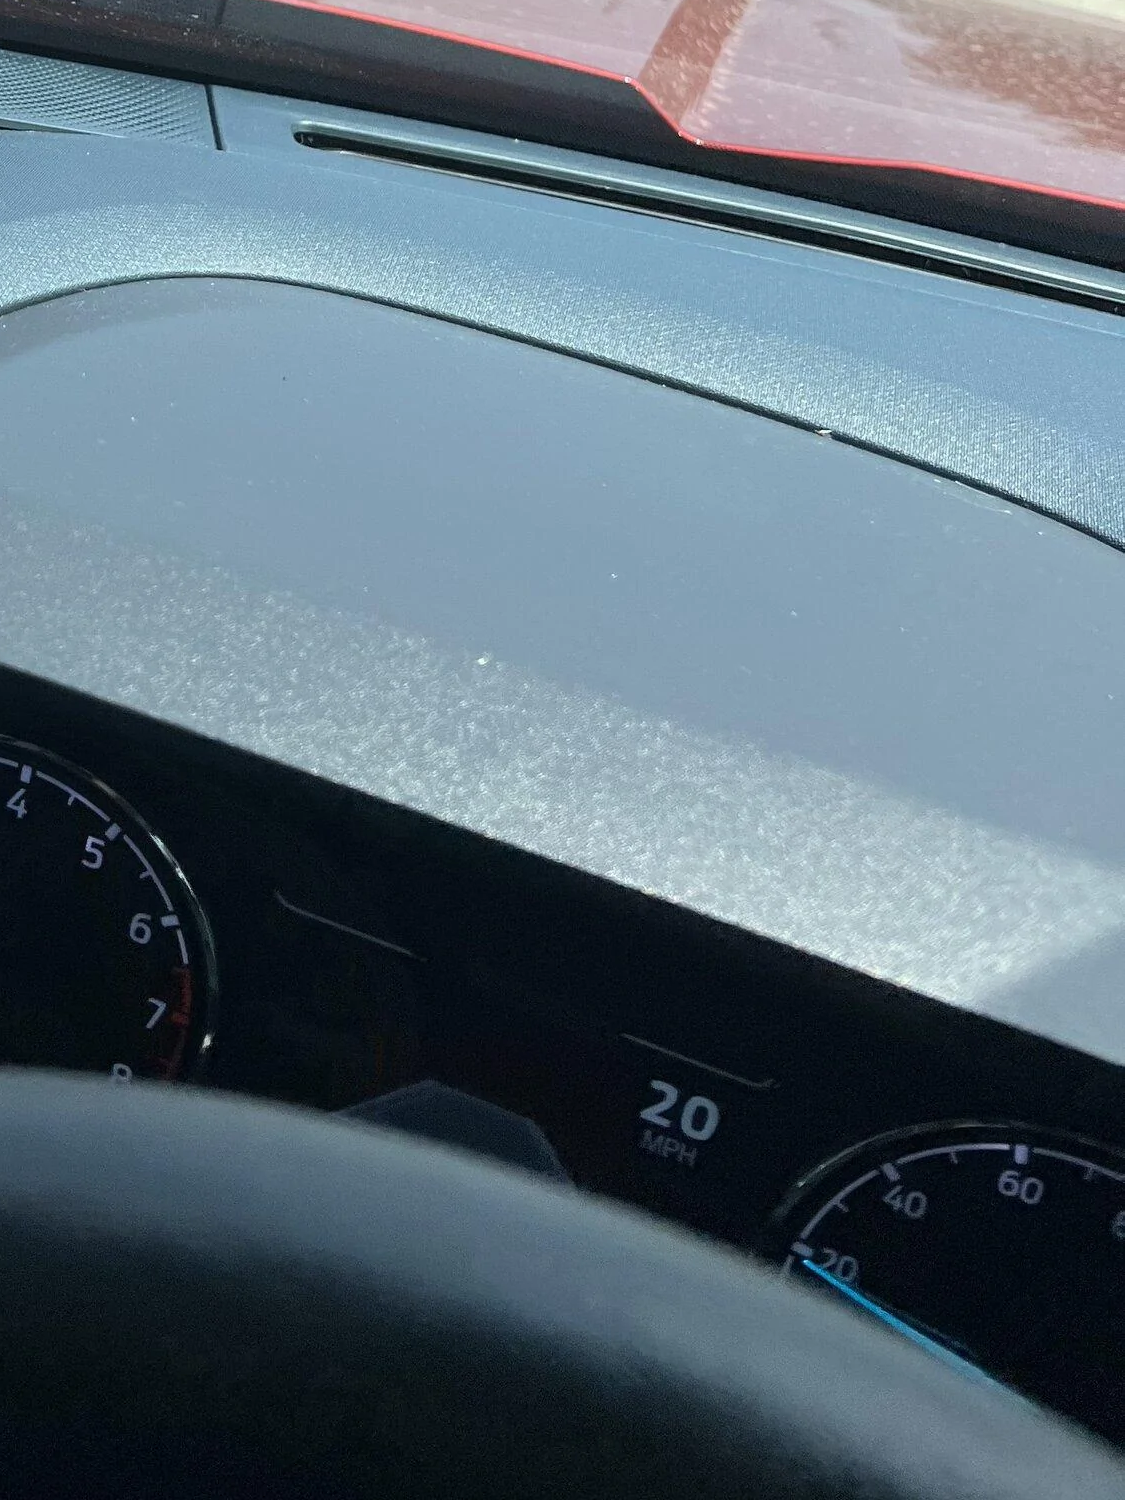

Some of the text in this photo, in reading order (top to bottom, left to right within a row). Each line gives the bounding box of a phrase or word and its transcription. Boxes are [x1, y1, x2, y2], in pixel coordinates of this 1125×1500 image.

[6, 787, 28, 819] 4
[81, 835, 105, 870] 5
[129, 913, 152, 945] 6
[145, 997, 167, 1029] 7
[639, 1079, 720, 1142] 20
[639, 1128, 699, 1167] MPH
[882, 1184, 928, 1219] 40
[997, 1169, 1045, 1205] 60
